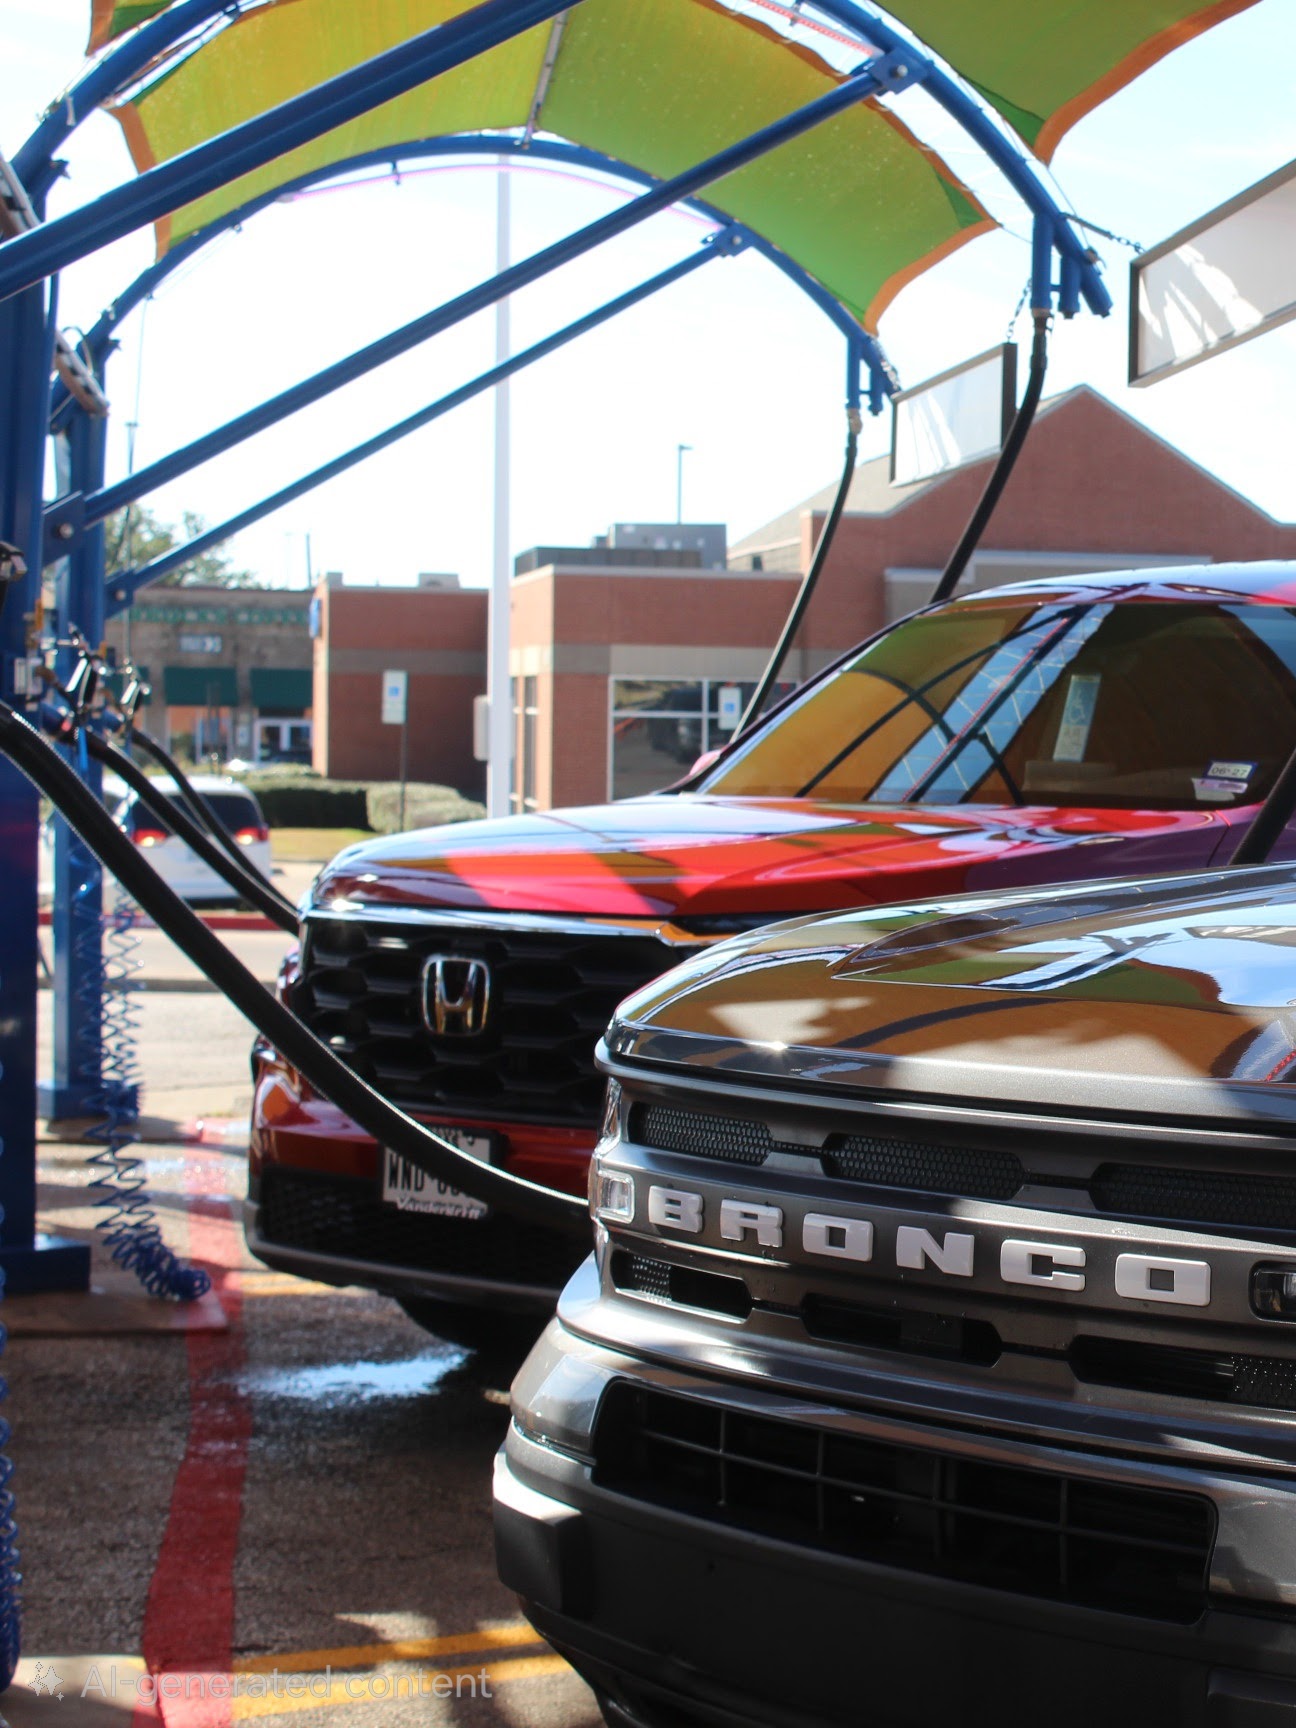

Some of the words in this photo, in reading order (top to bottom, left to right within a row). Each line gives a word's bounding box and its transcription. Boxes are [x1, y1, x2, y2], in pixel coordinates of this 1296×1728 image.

[1211, 767, 1226, 775] 06
[1232, 768, 1247, 776] 27
[648, 1184, 1211, 1306] BRONCO
